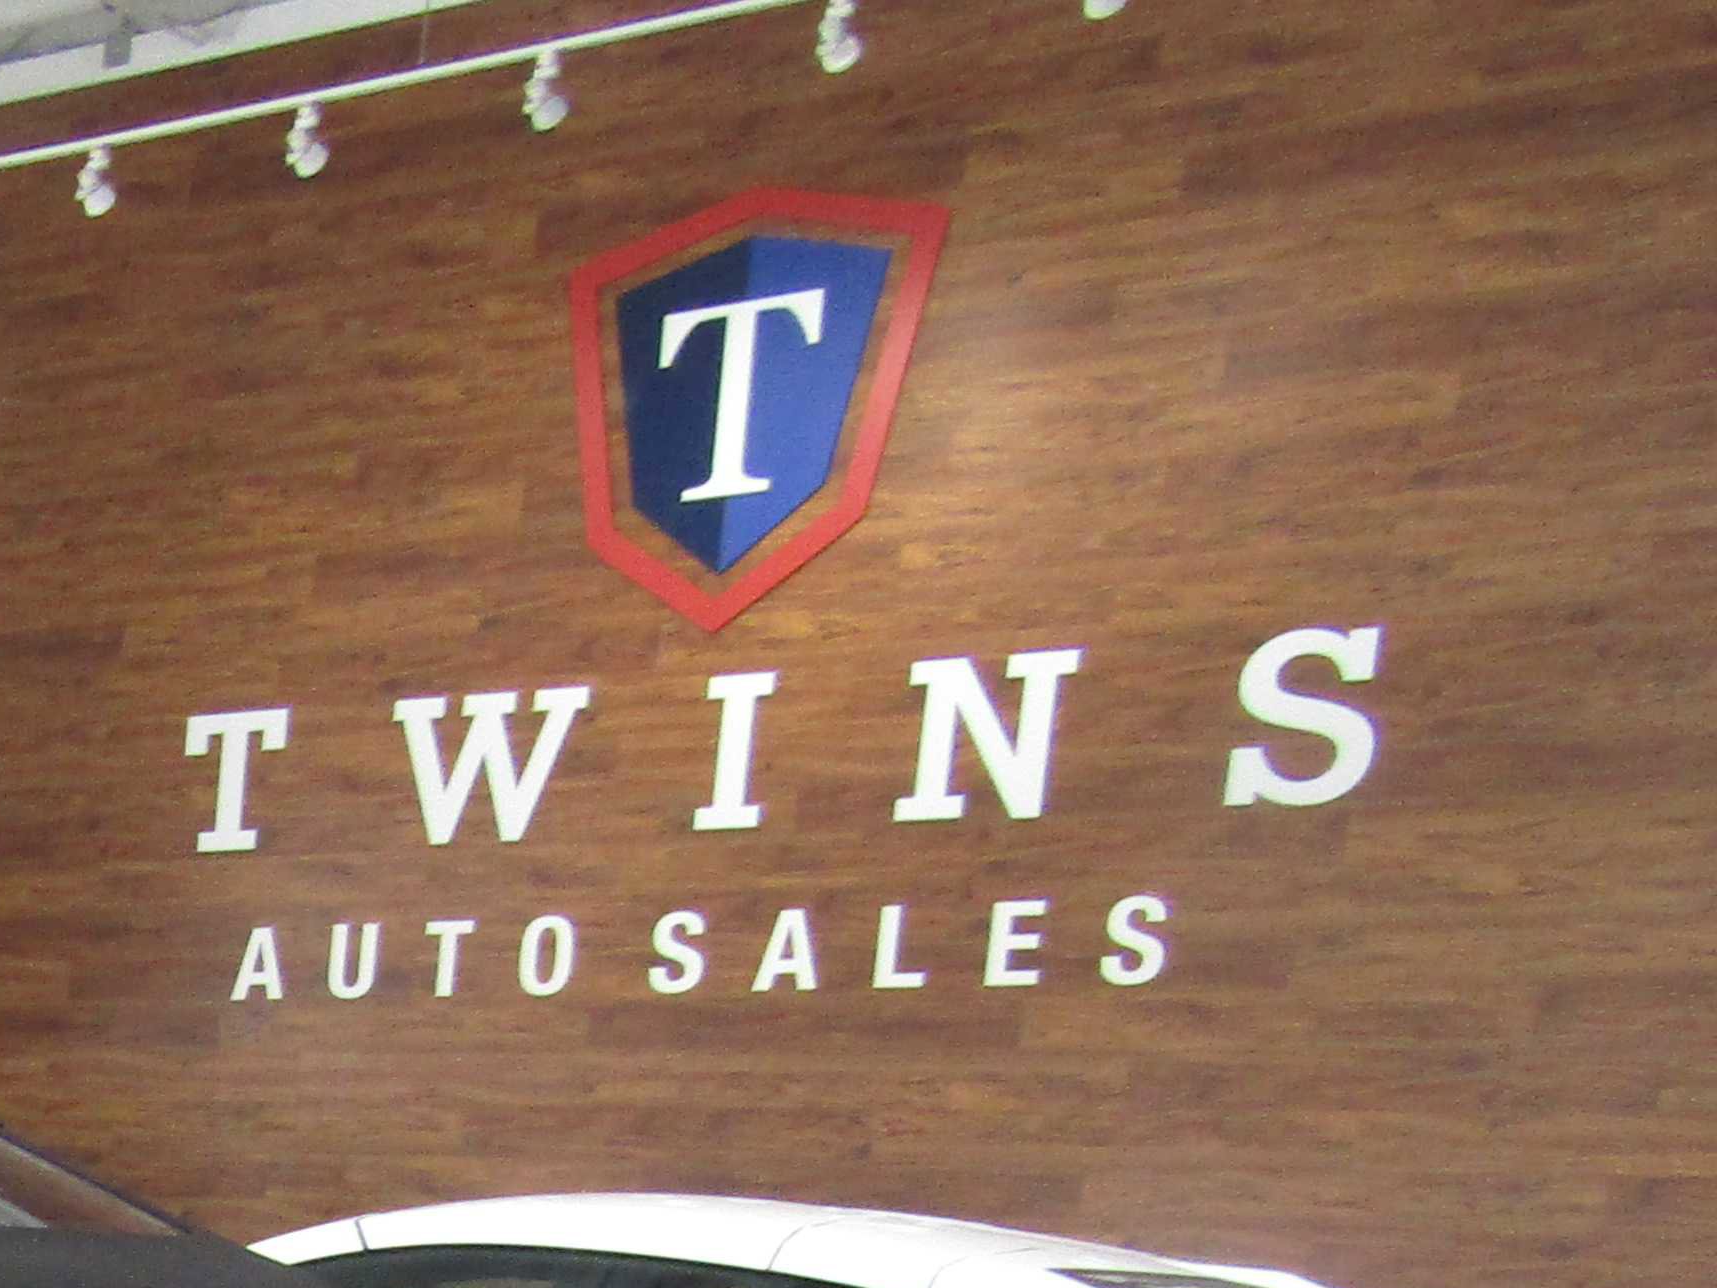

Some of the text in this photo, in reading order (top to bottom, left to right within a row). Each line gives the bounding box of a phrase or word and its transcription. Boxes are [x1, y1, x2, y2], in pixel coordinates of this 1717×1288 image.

[657, 287, 826, 503] T
[183, 626, 1384, 853] TWINS
[229, 893, 1170, 1002] AUTO SALES
